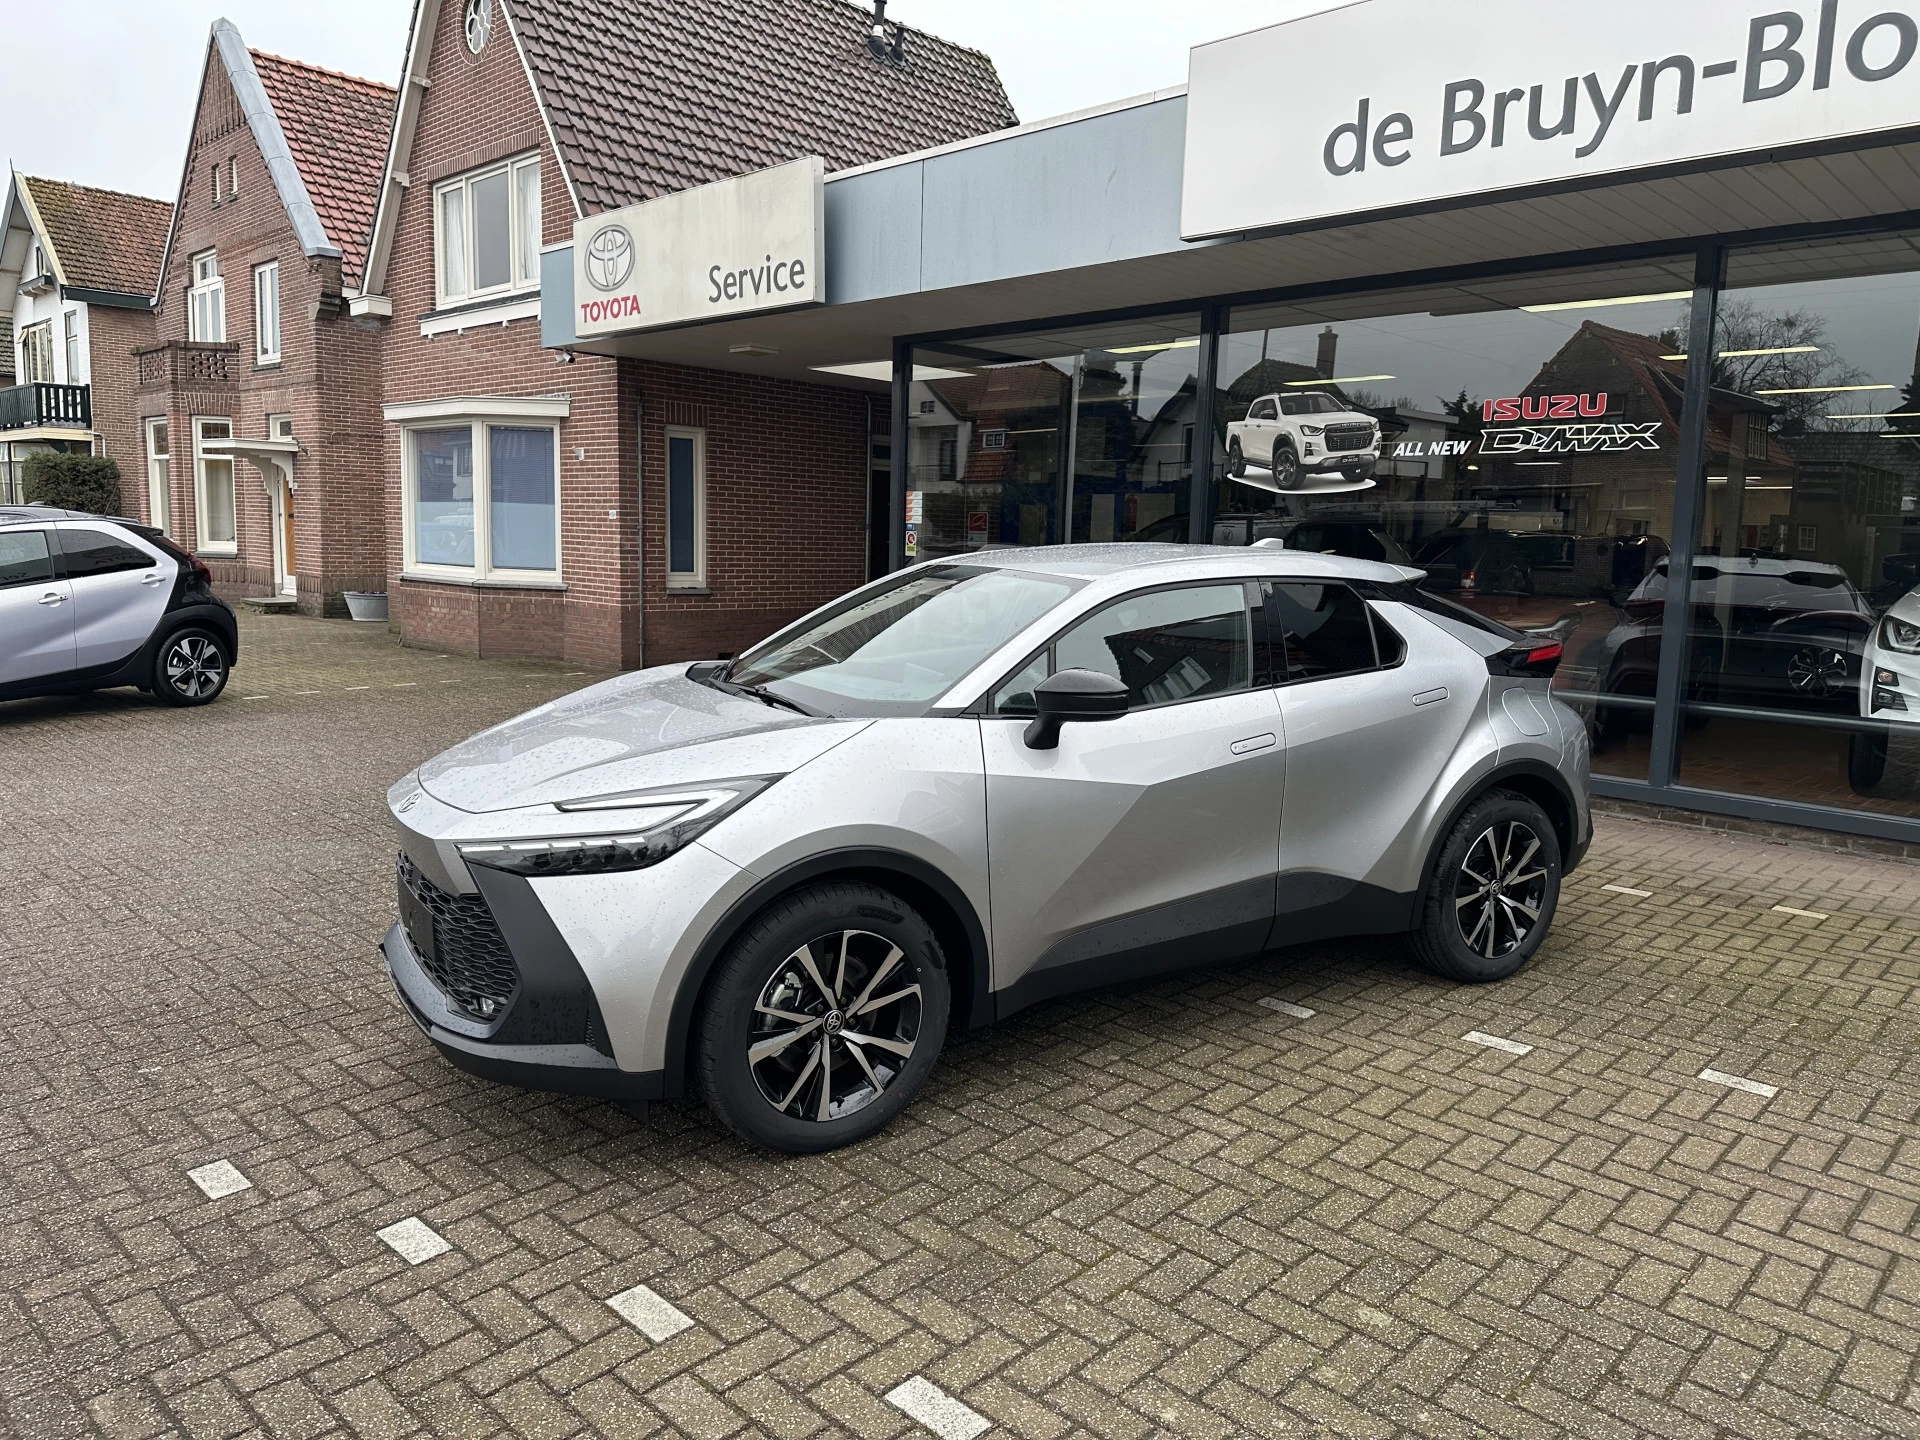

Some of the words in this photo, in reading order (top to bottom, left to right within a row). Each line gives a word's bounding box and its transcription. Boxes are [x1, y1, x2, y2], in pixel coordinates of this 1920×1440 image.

[1322, 98, 1414, 177] de
[1439, 0, 1919, 159] Bruyn-Blo
[708, 254, 806, 303] Service
[581, 294, 641, 324] TOYOTA
[1483, 393, 1608, 421] ISUZU
[1393, 442, 1425, 457] ALL
[1427, 440, 1471, 456] NEW
